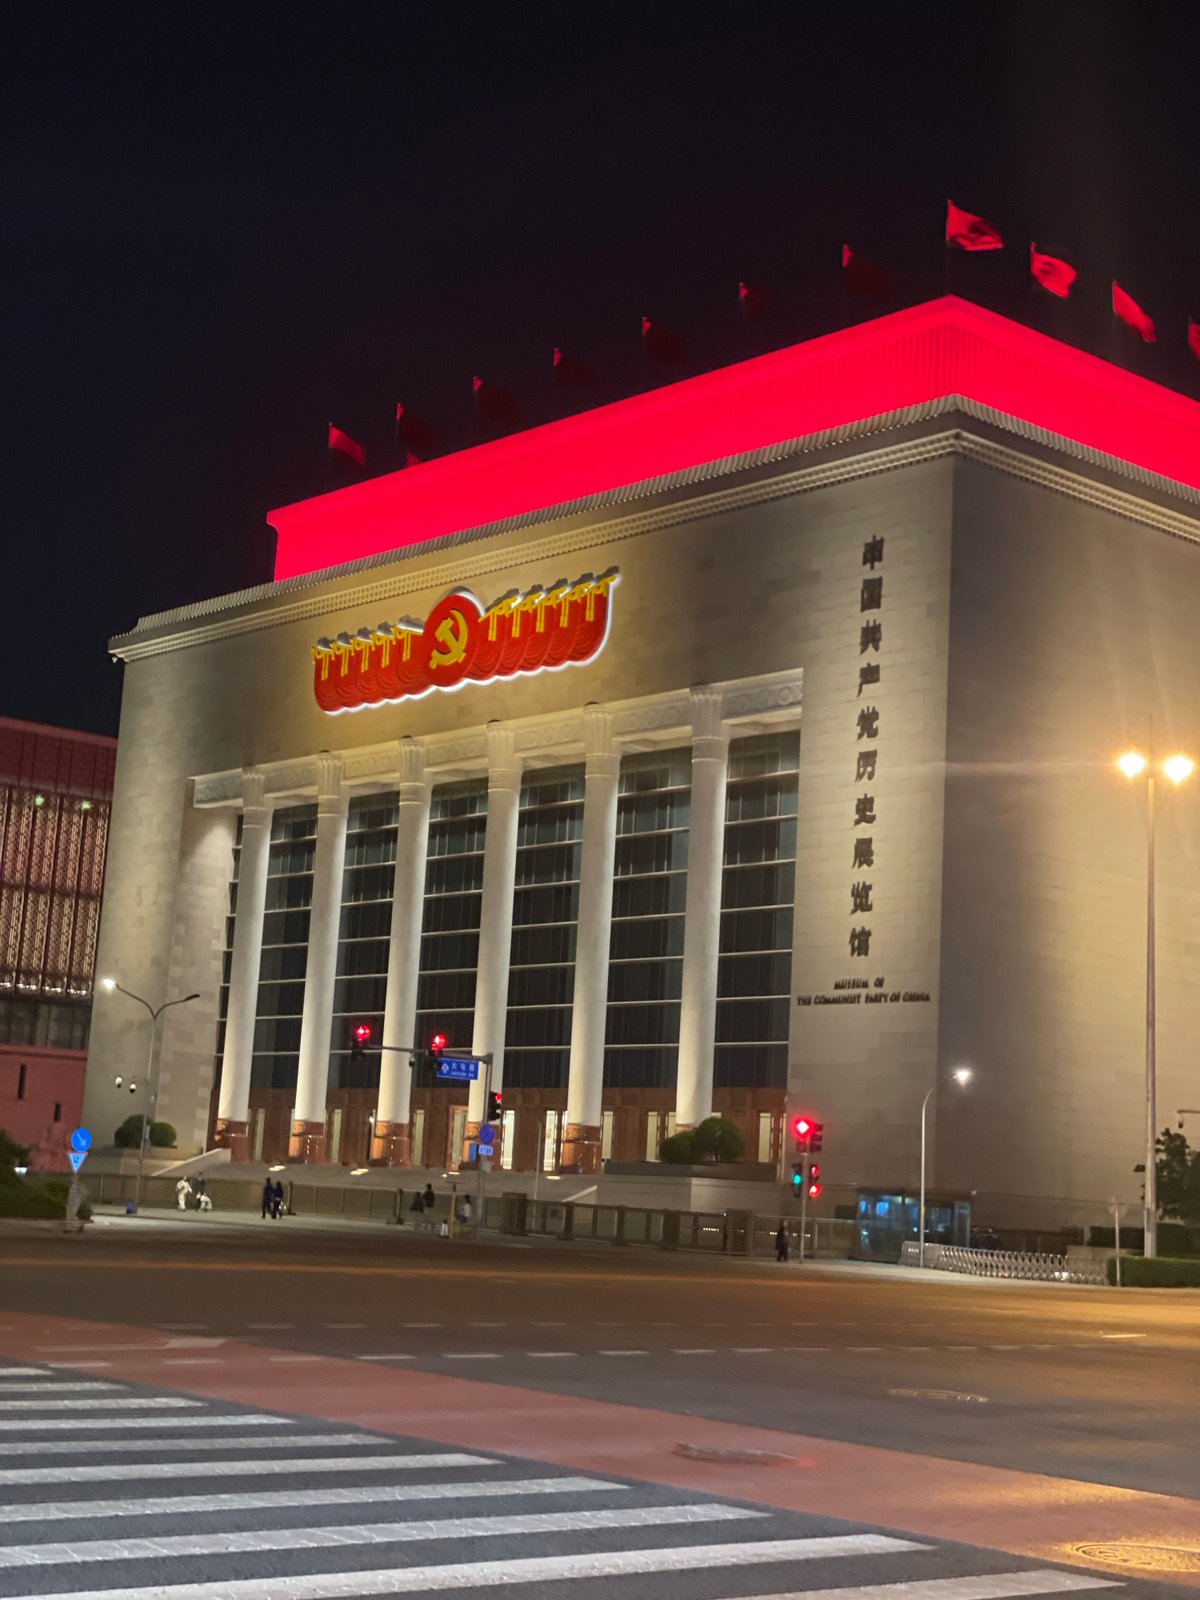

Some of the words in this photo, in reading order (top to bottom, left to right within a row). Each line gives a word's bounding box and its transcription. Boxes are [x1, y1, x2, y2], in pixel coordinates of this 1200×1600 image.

[849, 535, 884, 957] 中国共产党历史展览馆
[834, 979, 869, 990] MUSEUM
[874, 977, 885, 988] OF
[797, 995, 812, 1006] THE
[814, 993, 861, 1005] COMMUNIST
[865, 992, 889, 1003] PARTY
[889, 991, 901, 1002] OF
[902, 991, 930, 1003] CHINA
